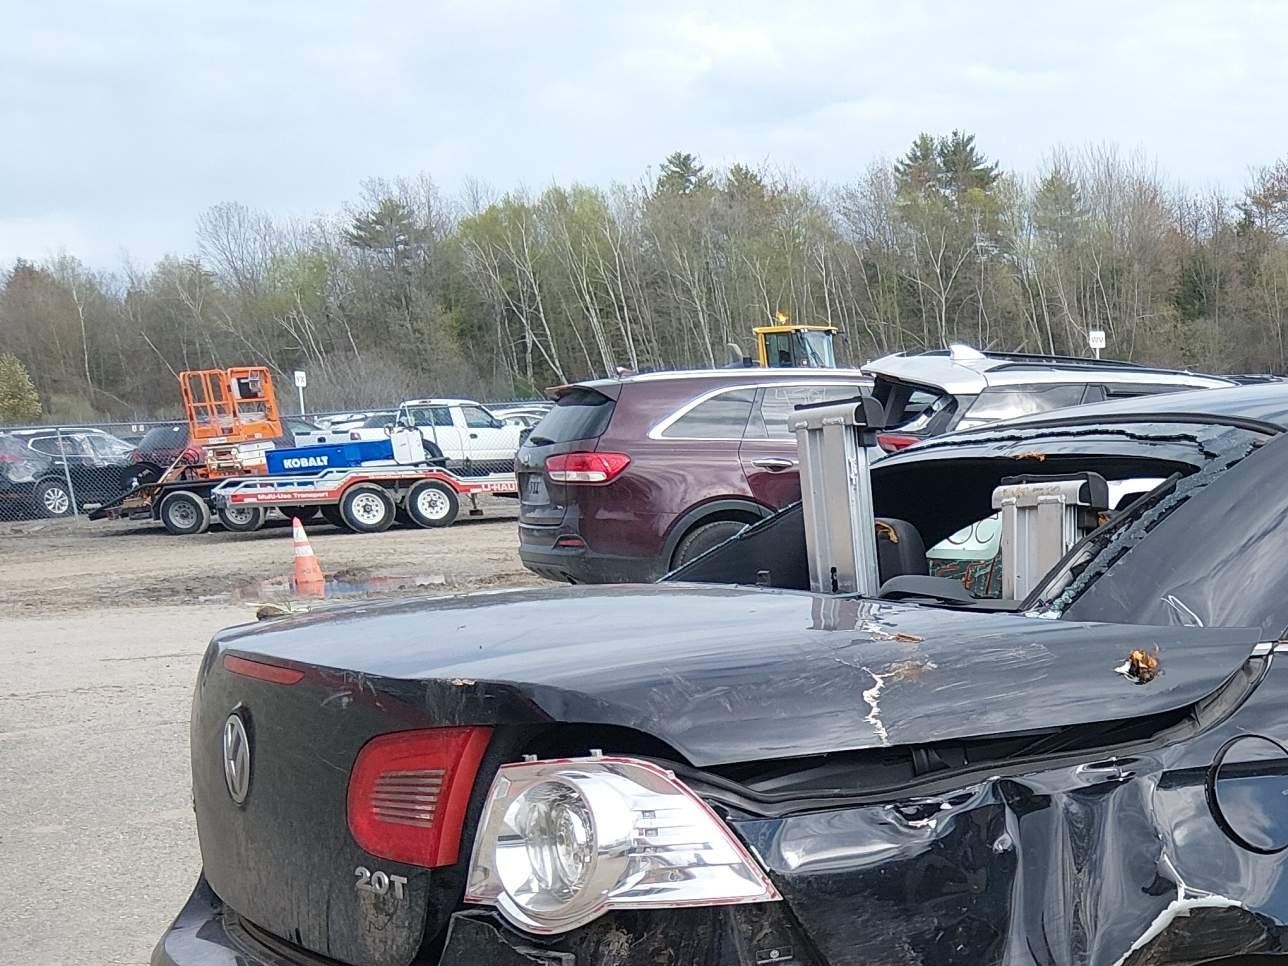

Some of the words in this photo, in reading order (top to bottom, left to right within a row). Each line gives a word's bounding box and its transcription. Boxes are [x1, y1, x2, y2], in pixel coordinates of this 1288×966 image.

[283, 456, 329, 469] KOBALT
[257, 492, 292, 500] Multi-Use
[293, 491, 328, 499] Transport
